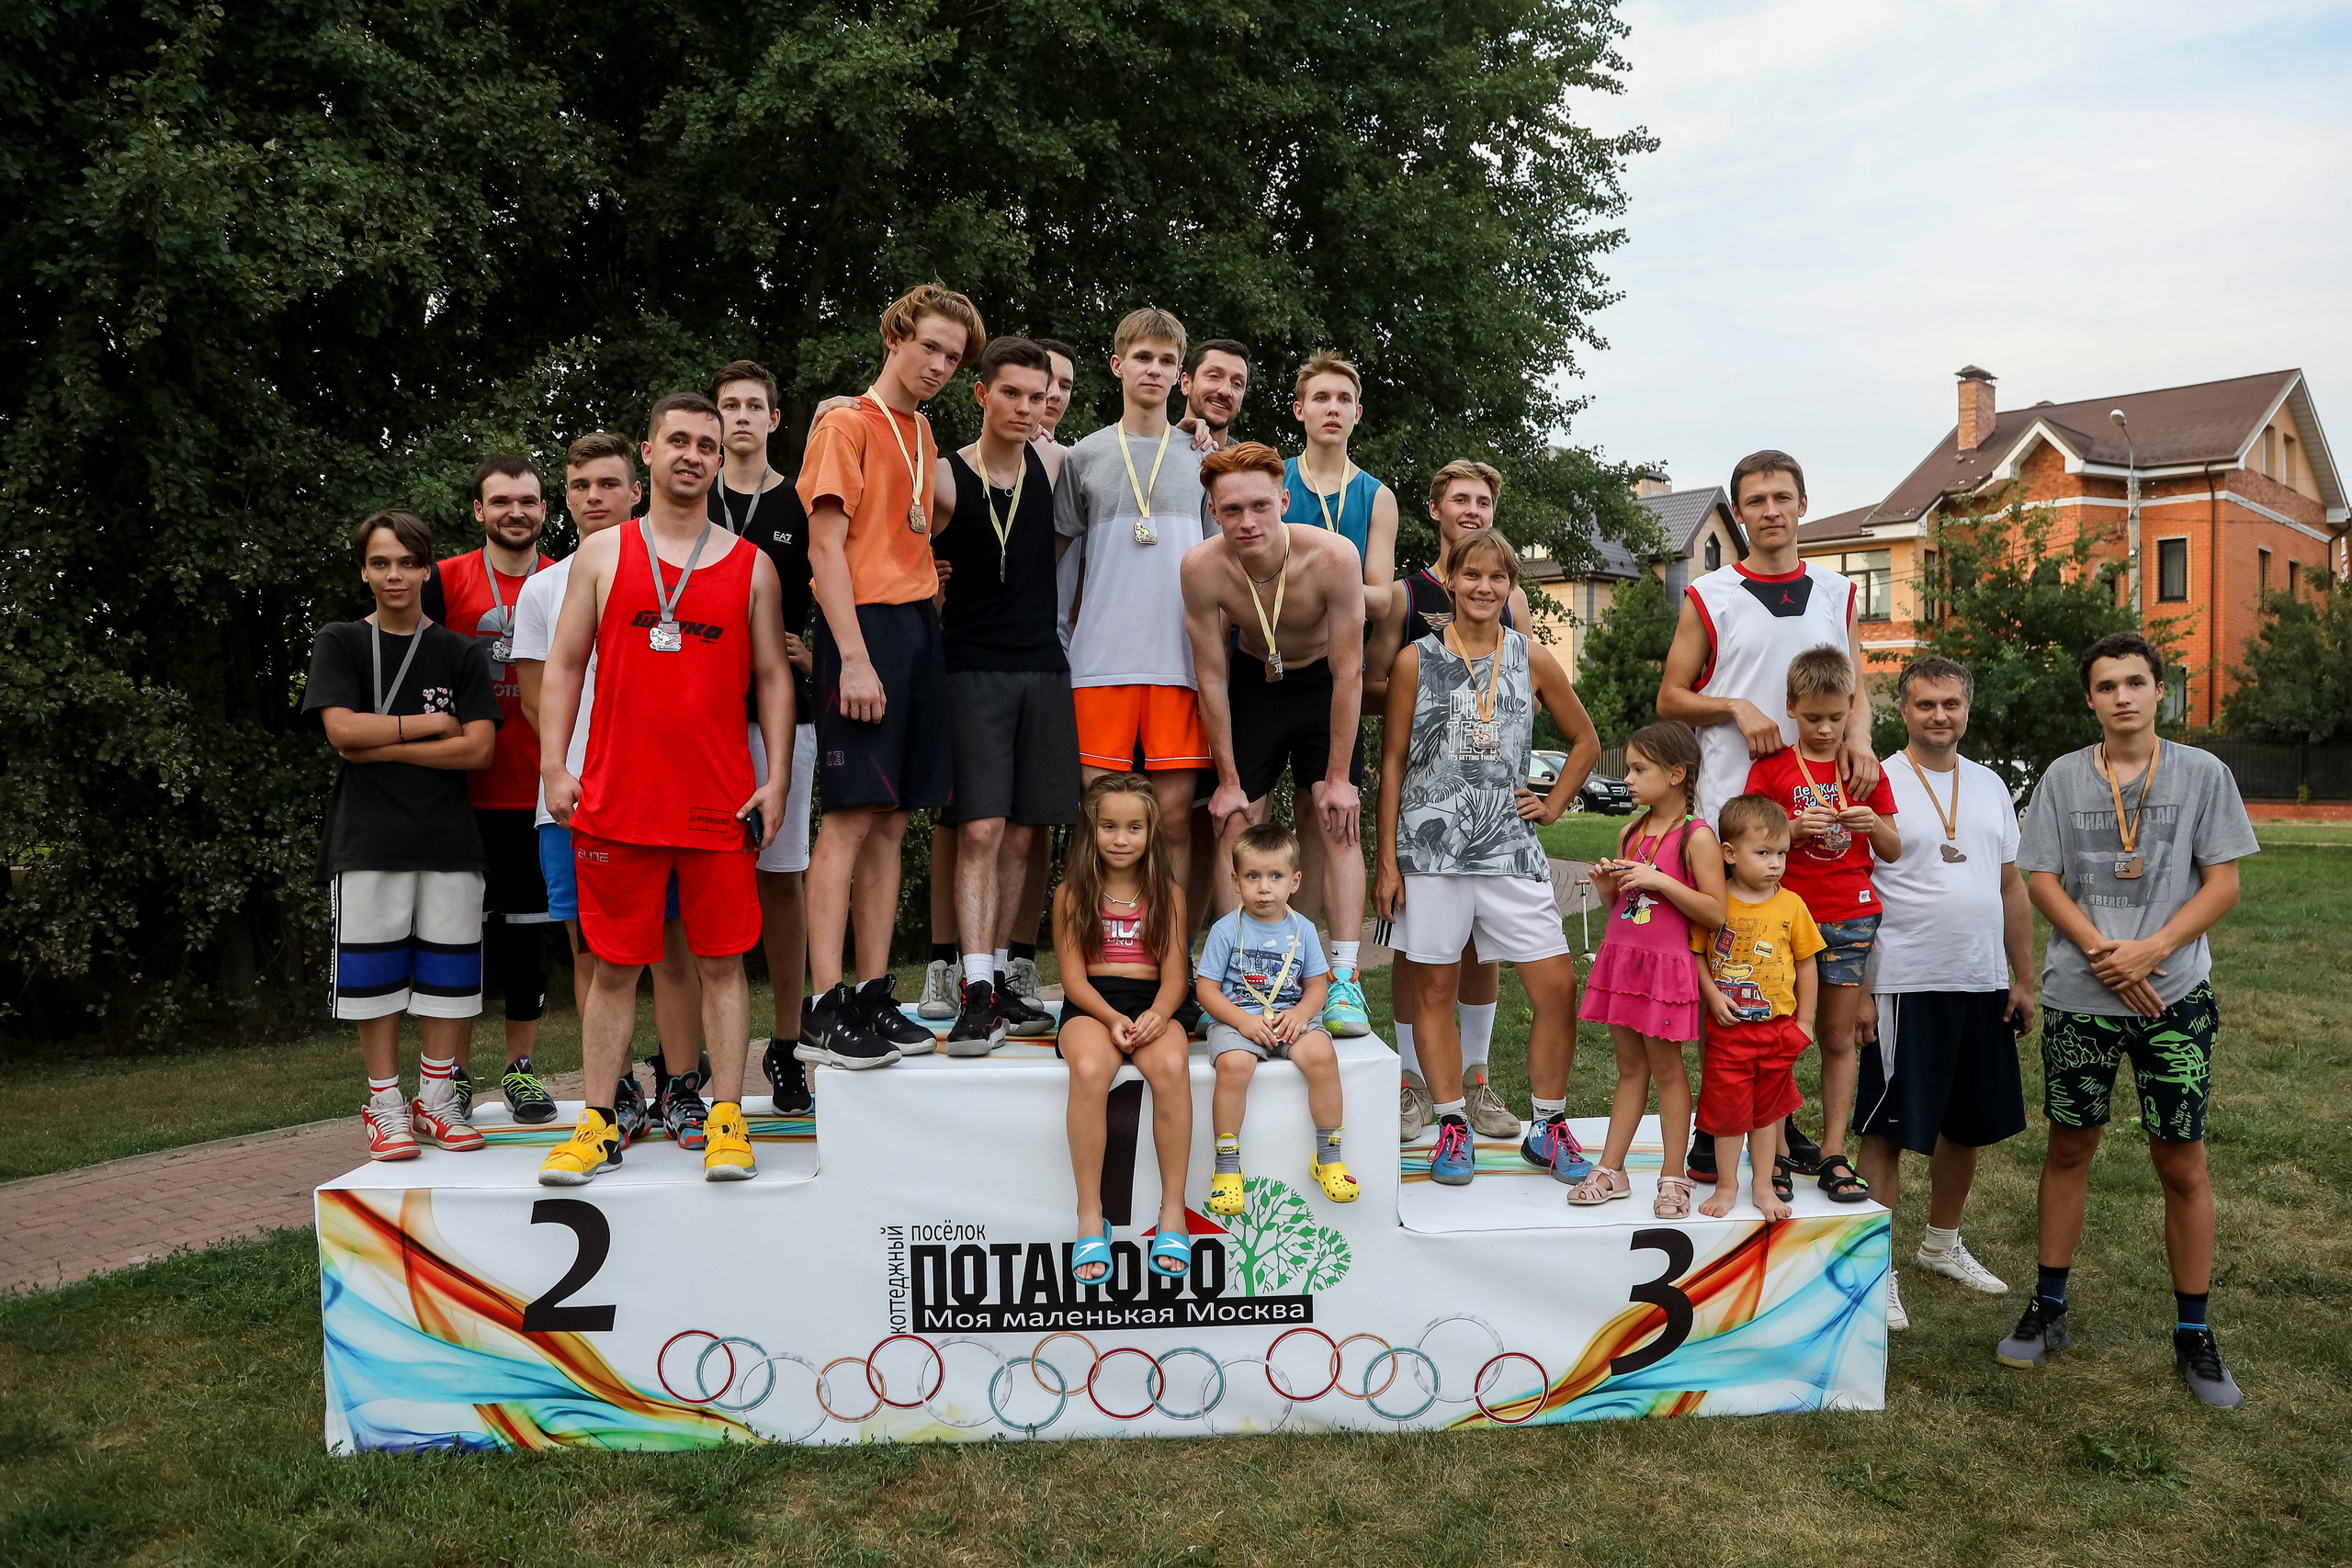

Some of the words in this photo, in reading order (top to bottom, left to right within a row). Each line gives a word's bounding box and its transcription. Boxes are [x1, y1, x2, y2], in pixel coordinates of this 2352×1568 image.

[774, 530, 793, 542] EA7
[1792, 783, 1838, 804] Декий
[578, 847, 609, 863] ELITE
[911, 1219, 986, 1241] посёлок
[522, 1199, 616, 1332] 2
[880, 1225, 910, 1334] коттеджный
[1611, 1228, 1695, 1376] 3
[924, 1308, 991, 1328] Моя
[1002, 1307, 1174, 1328] маленькая
[1187, 1302, 1305, 1322] Москва
